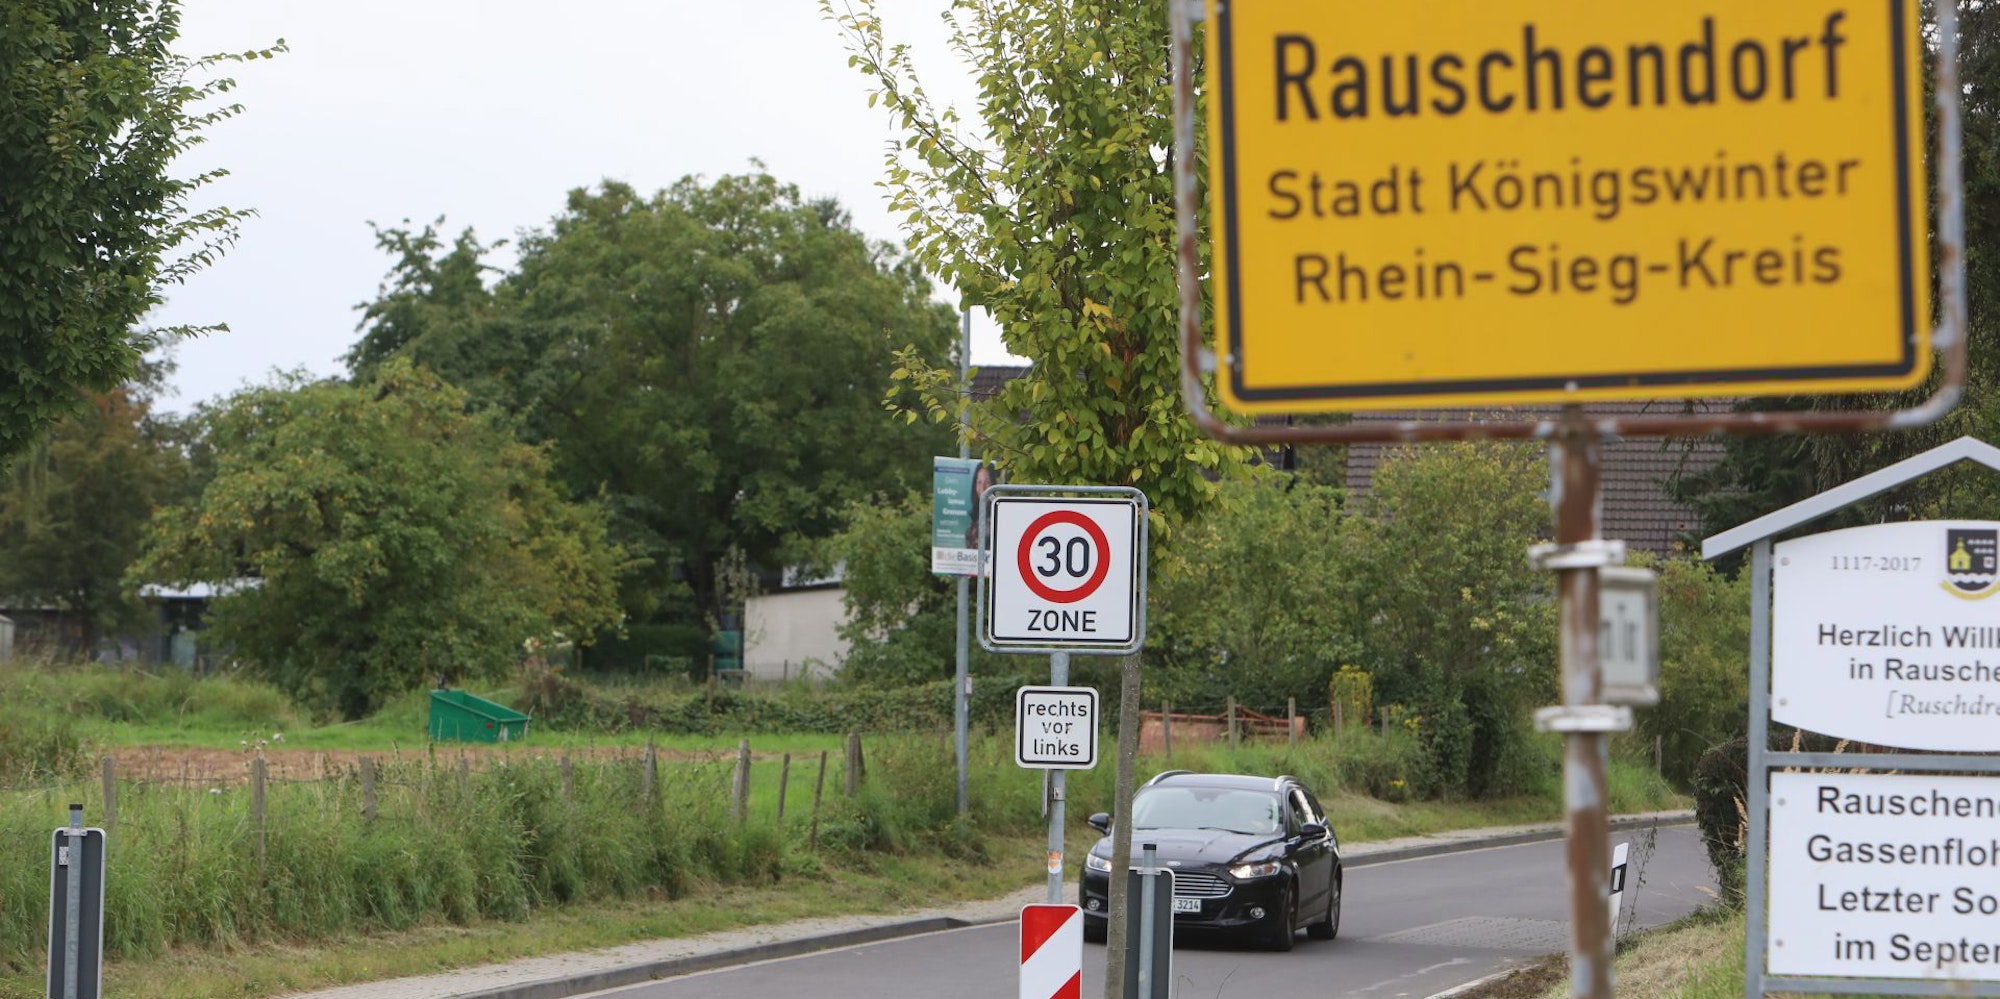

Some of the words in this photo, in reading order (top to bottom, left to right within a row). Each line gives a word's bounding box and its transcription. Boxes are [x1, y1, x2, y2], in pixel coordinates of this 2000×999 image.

[1274, 11, 1846, 122] Rauschendorf
[1267, 166, 1425, 220] Stadt
[1449, 152, 1859, 221] Königswinter
[1294, 236, 1841, 306] Rhein-Sieg-Kreis
[1036, 536, 1090, 578] 30
[1833, 556, 1921, 571] 1117-2017
[1028, 610, 1096, 632] ZONE
[1819, 624, 1930, 647] Herzlich
[1943, 627, 2000, 648] Will
[1851, 658, 1873, 679] in
[1028, 700, 1086, 716] rechts
[1042, 722, 1072, 734] vor
[1034, 739, 1079, 755] links
[1818, 786, 2000, 818] Rauschen
[1177, 899, 1199, 910] 3214
[1819, 884, 1939, 913] Letzter
[1836, 933, 1874, 960] im
